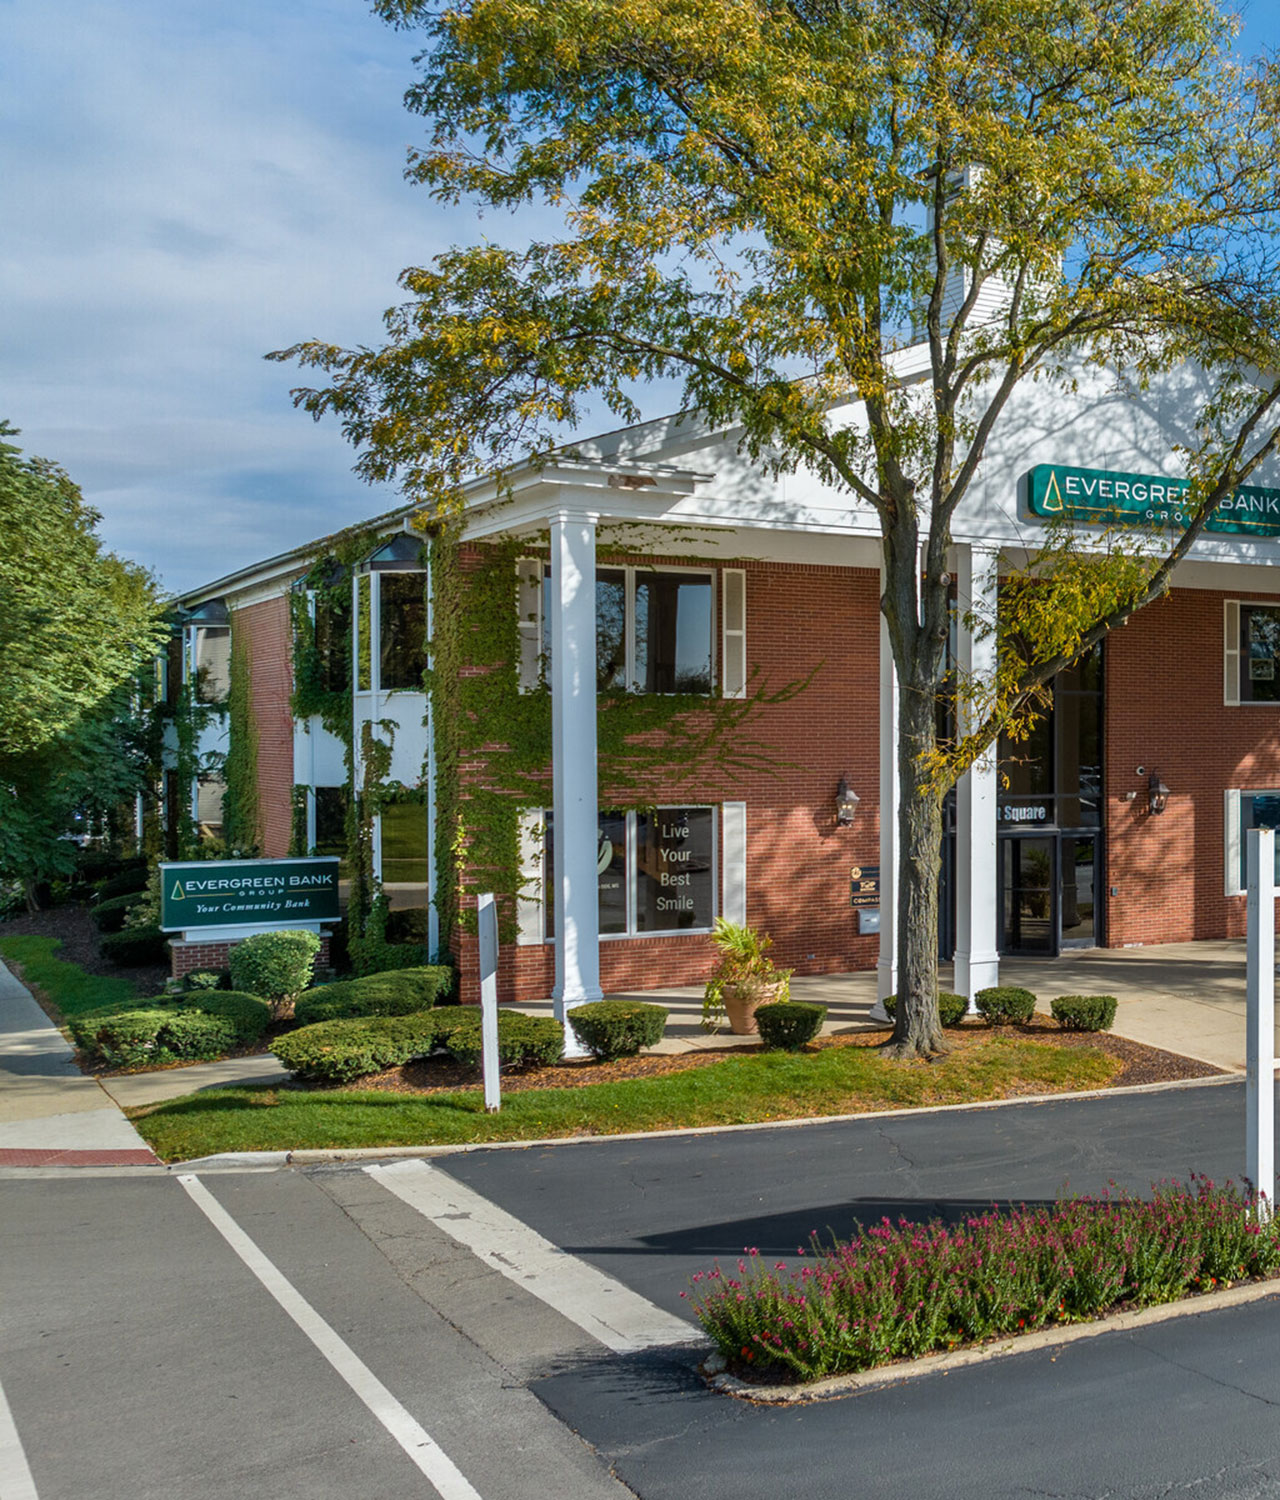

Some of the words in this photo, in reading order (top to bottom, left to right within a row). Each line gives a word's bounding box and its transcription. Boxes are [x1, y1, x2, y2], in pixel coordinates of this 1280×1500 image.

[1066, 476, 1204, 506] EVERGREE
[1220, 492, 1280, 514] BANK
[1146, 510, 1210, 523] GRO
[1004, 805, 1046, 821] Square
[662, 823, 690, 838] Live
[660, 848, 692, 862] Your
[186, 877, 285, 890] EVERGREEN
[289, 874, 333, 886] BANK
[660, 872, 691, 887] Best
[197, 904, 220, 914] Your
[222, 901, 281, 912] Community
[285, 898, 310, 909] Bank
[656, 895, 694, 911] Smile
[853, 897, 880, 905] COMPAS
